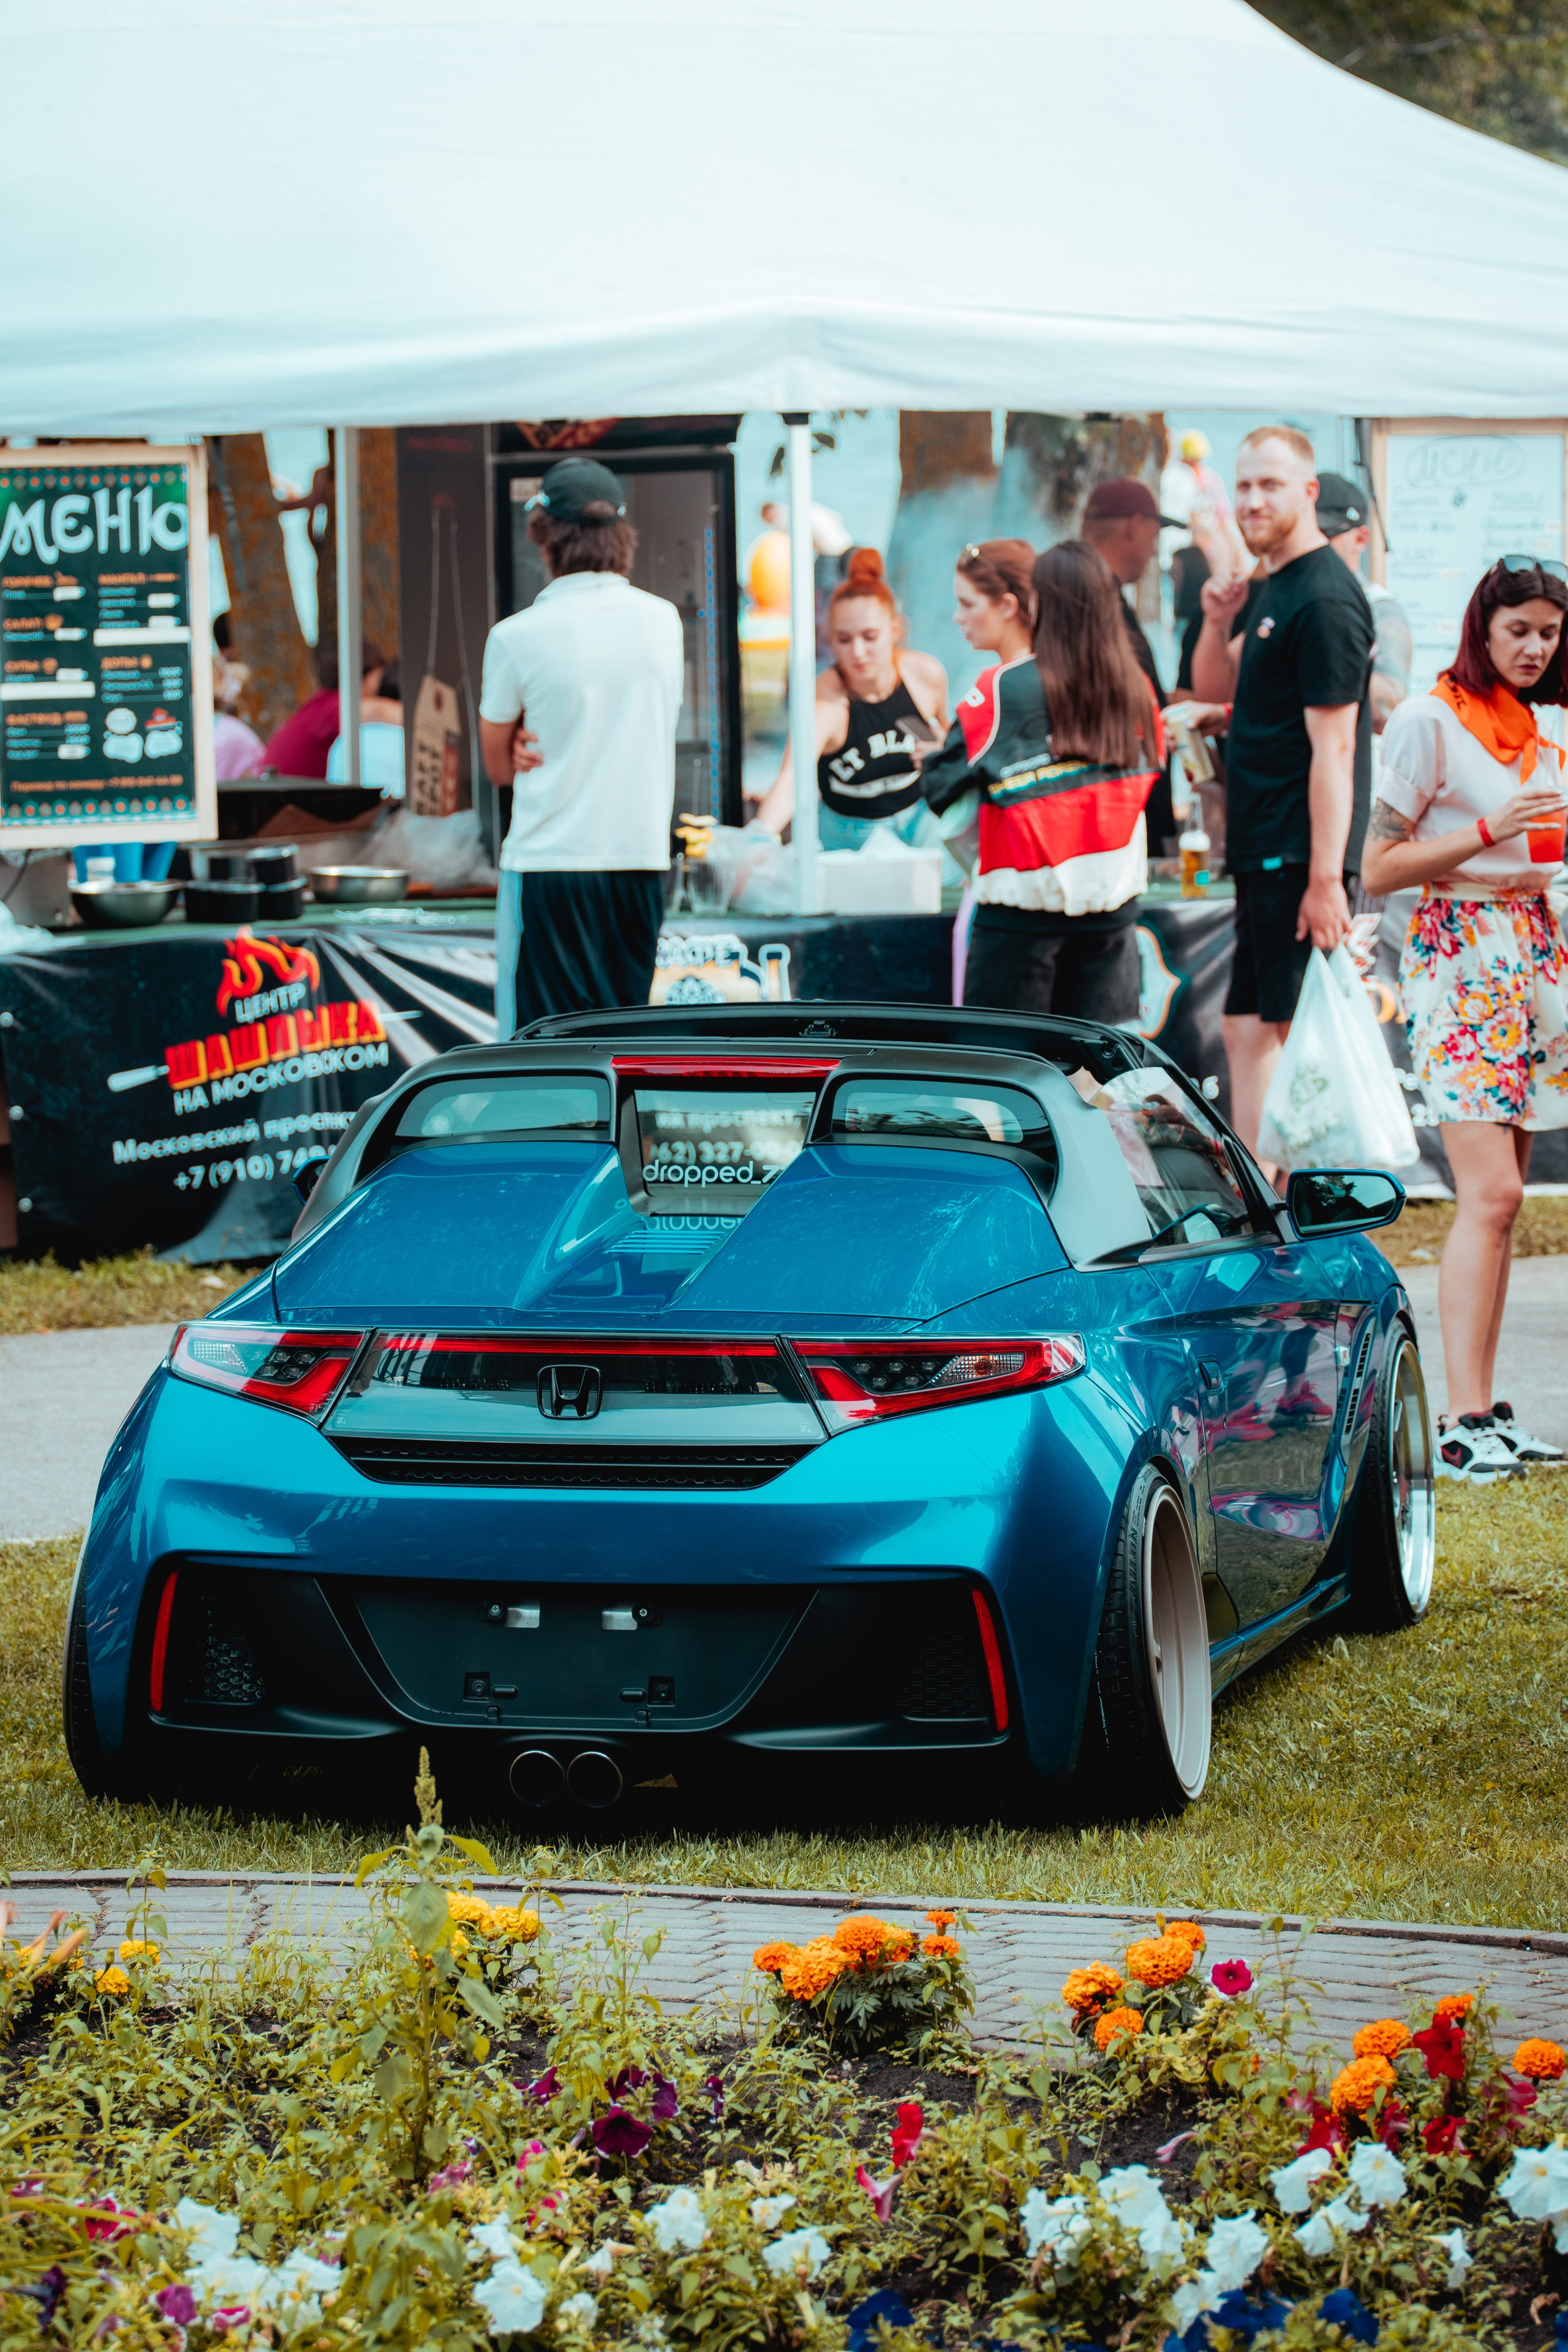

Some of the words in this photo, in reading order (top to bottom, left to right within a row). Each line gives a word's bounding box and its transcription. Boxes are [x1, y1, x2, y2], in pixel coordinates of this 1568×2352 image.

[0, 485, 188, 565] МЕНЮ
[235, 982, 306, 1023] ЦЕНТР
[164, 998, 388, 1090] ШАШЛЫКА
[173, 1086, 209, 1115] НА
[112, 1118, 260, 1164] Московский
[174, 1166, 206, 1190] +7
[208, 1153, 274, 1188] (910)
[643, 1159, 785, 1188] dropped_7
